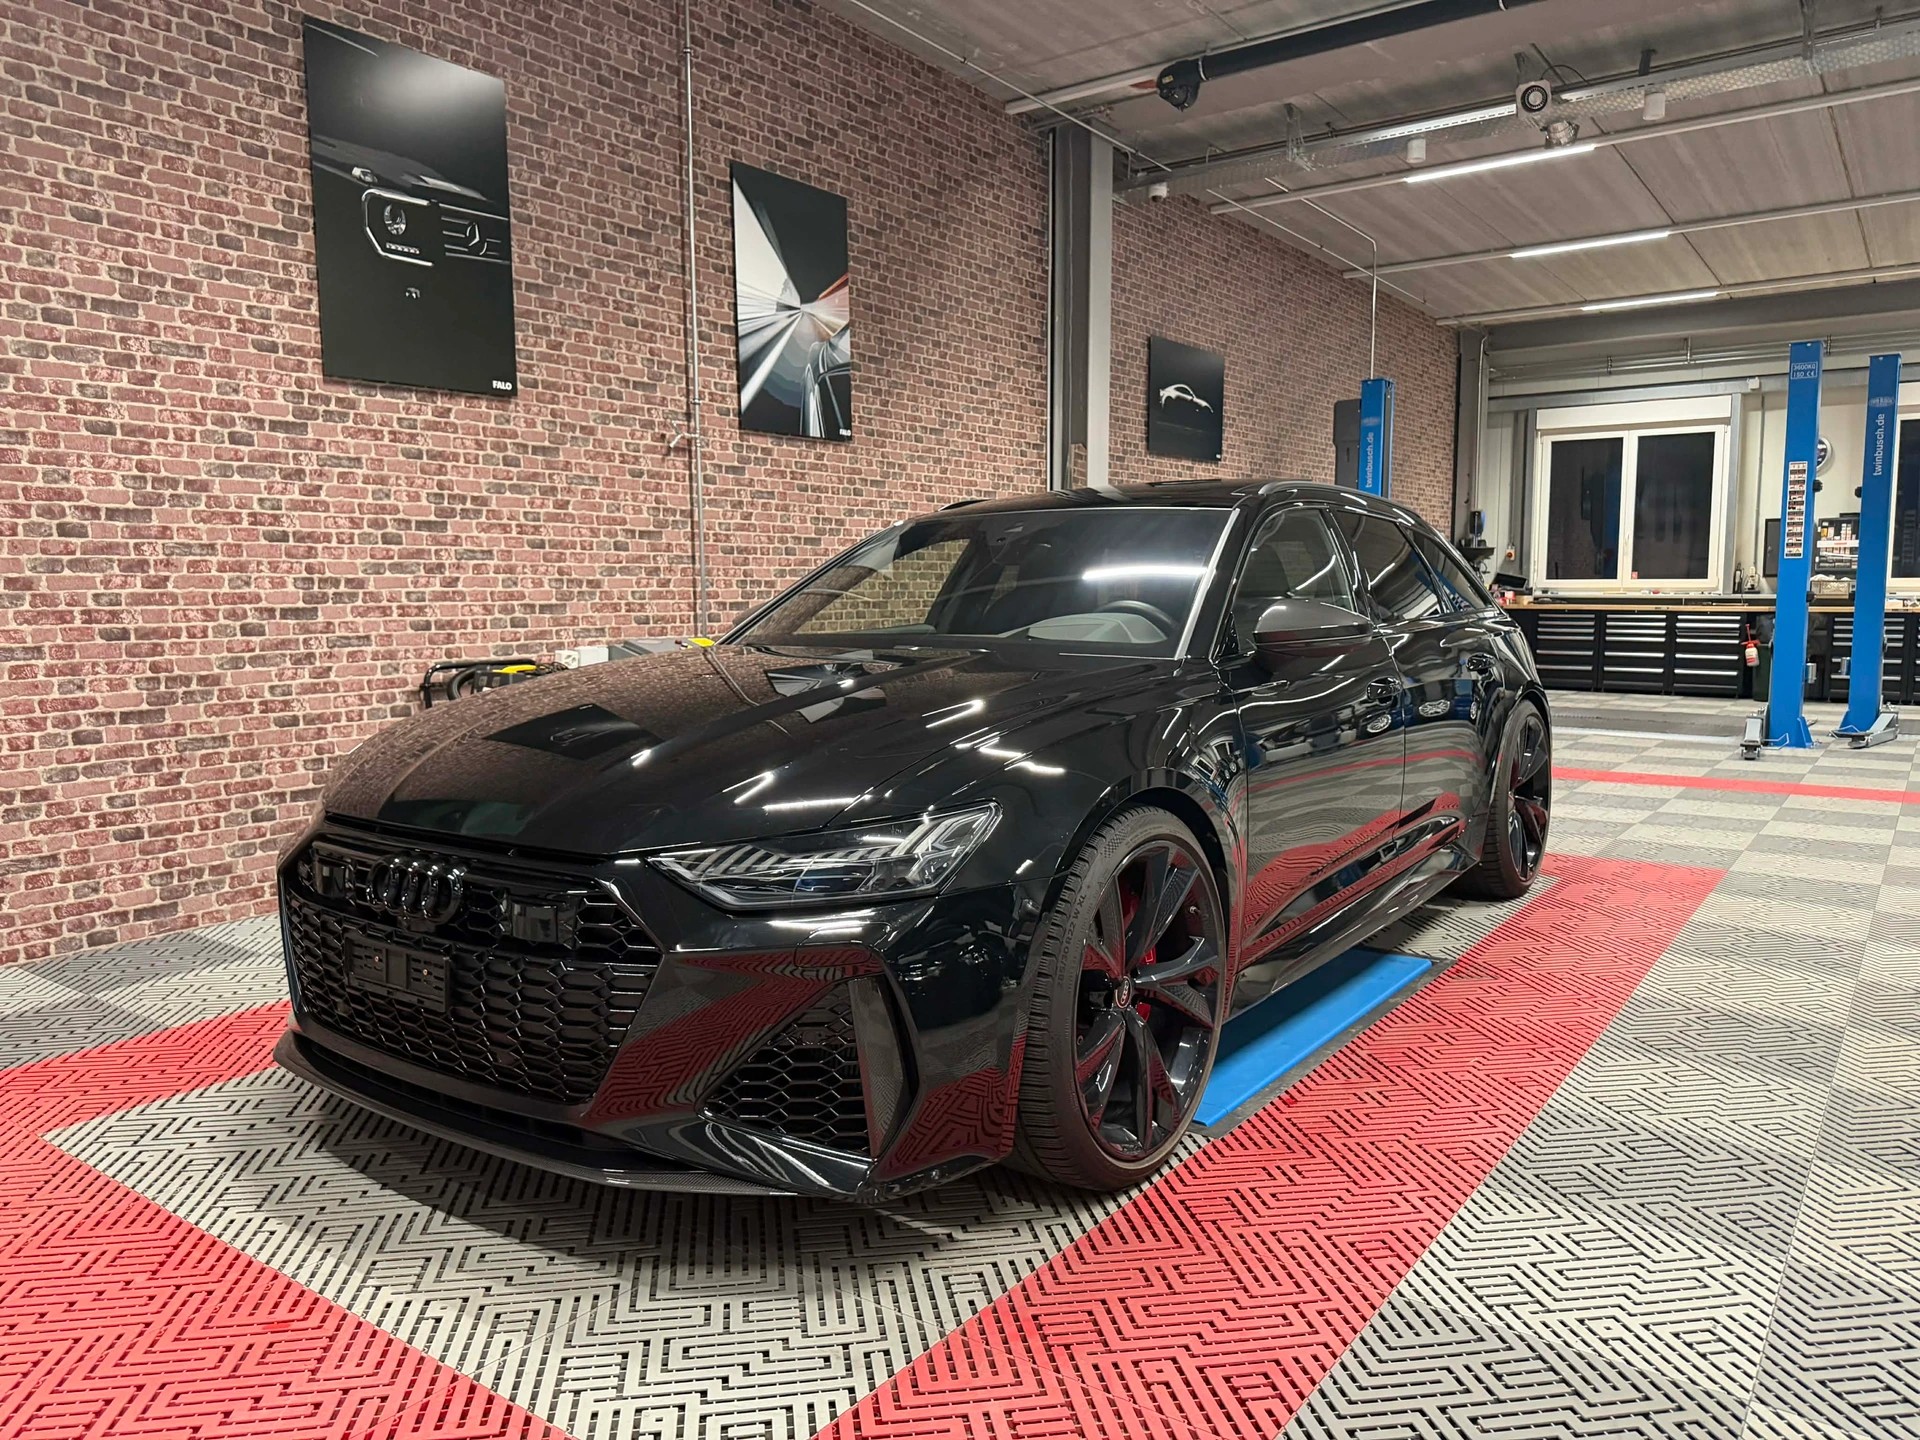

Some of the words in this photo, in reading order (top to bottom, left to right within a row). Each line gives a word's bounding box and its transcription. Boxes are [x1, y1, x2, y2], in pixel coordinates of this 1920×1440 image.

[492, 380, 512, 390] FALO
[1365, 432, 1374, 488] twinbusch.de
[1873, 413, 1885, 476] twinbusch.de
